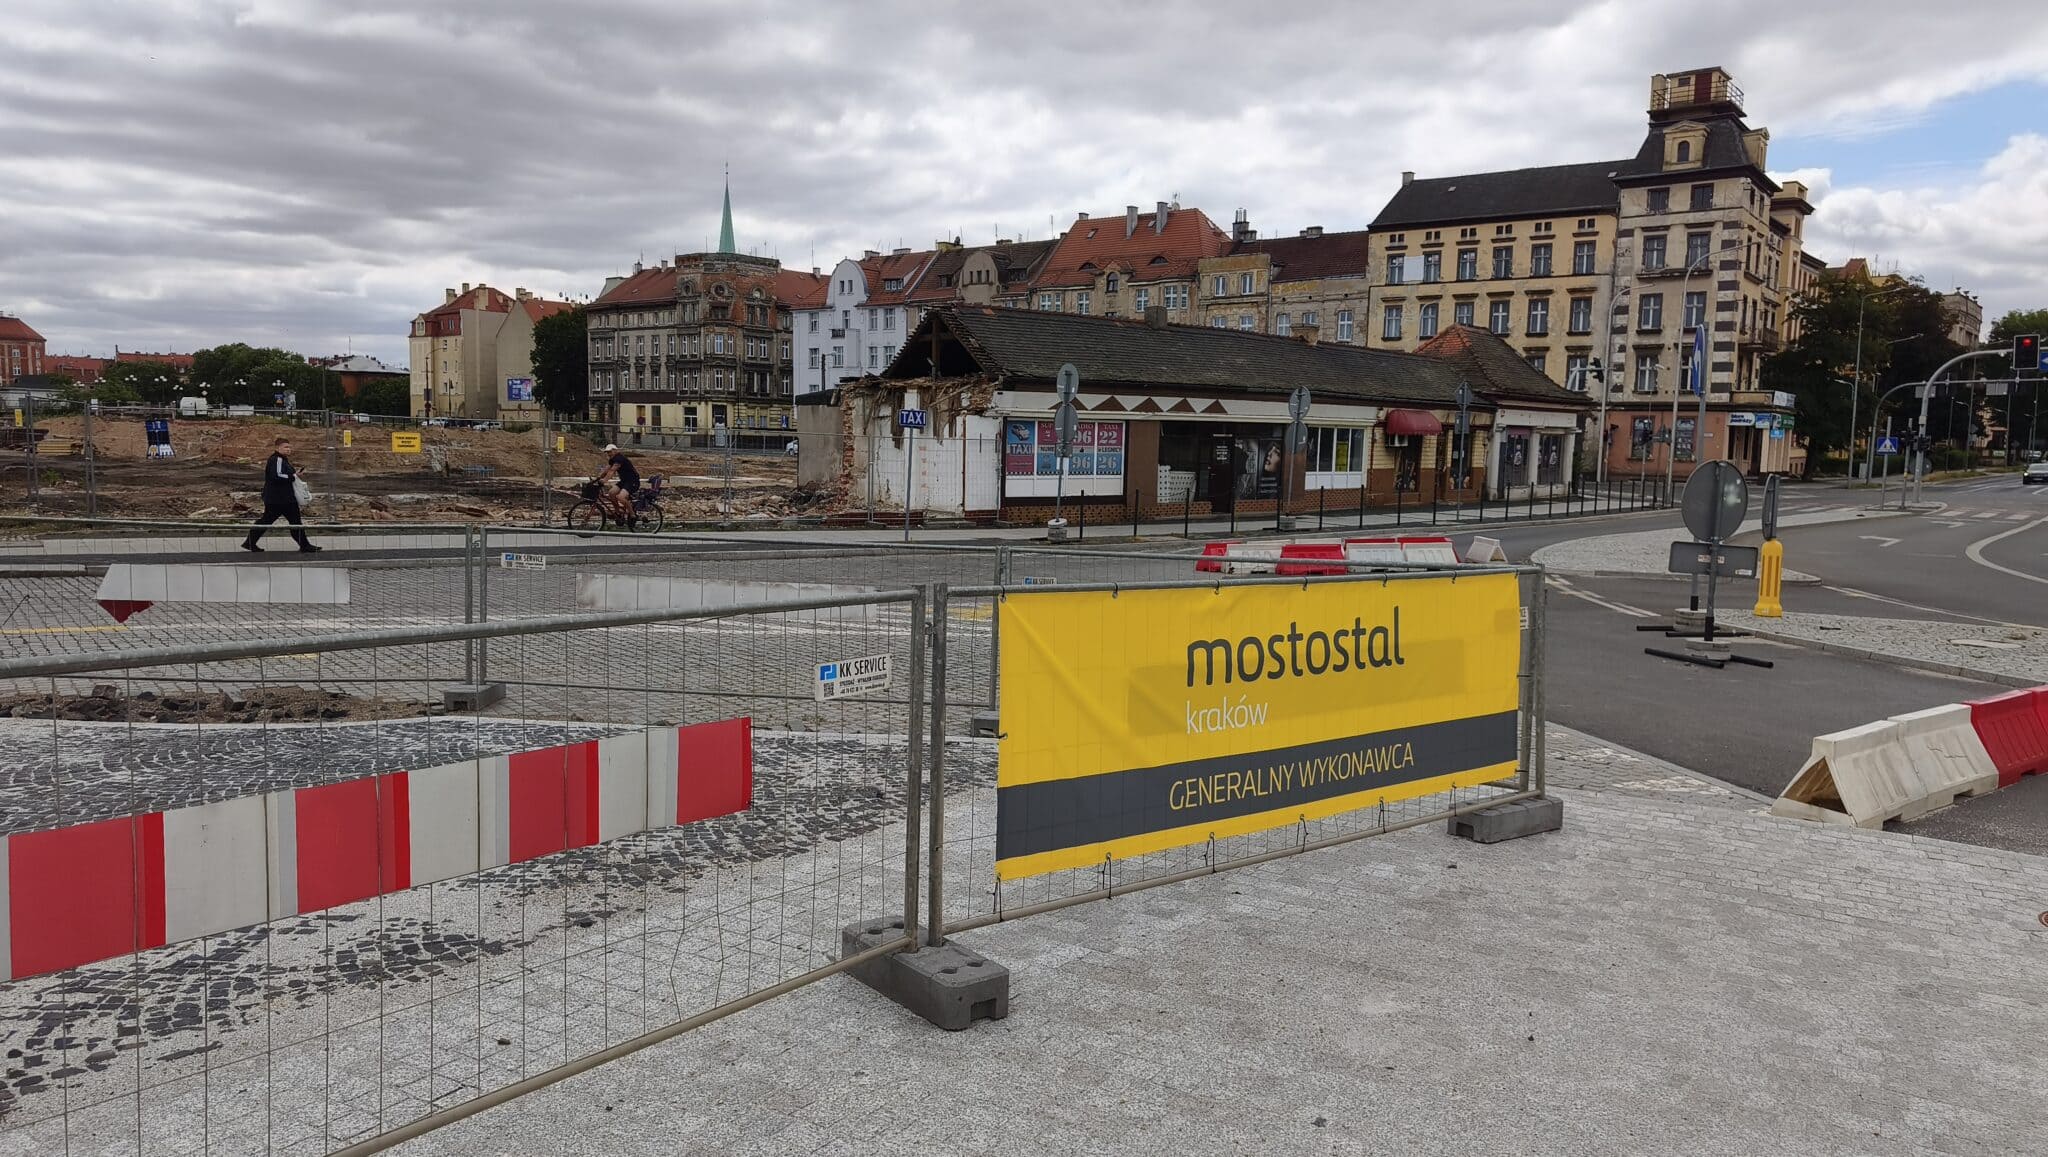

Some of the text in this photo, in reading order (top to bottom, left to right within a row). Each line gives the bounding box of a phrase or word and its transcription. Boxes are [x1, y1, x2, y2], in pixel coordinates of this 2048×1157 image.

[901, 411, 926, 425] TAXI
[1099, 430, 1117, 444] 22
[1011, 444, 1032, 455] TAXI
[1072, 456, 1117, 469] 96 26
[1187, 606, 1405, 687] mostostal
[840, 662, 852, 678] KK
[854, 656, 886, 675] SERVICE
[1186, 694, 1269, 735] kraków
[1169, 742, 1415, 811] GENERALNY WYKONAWCA
